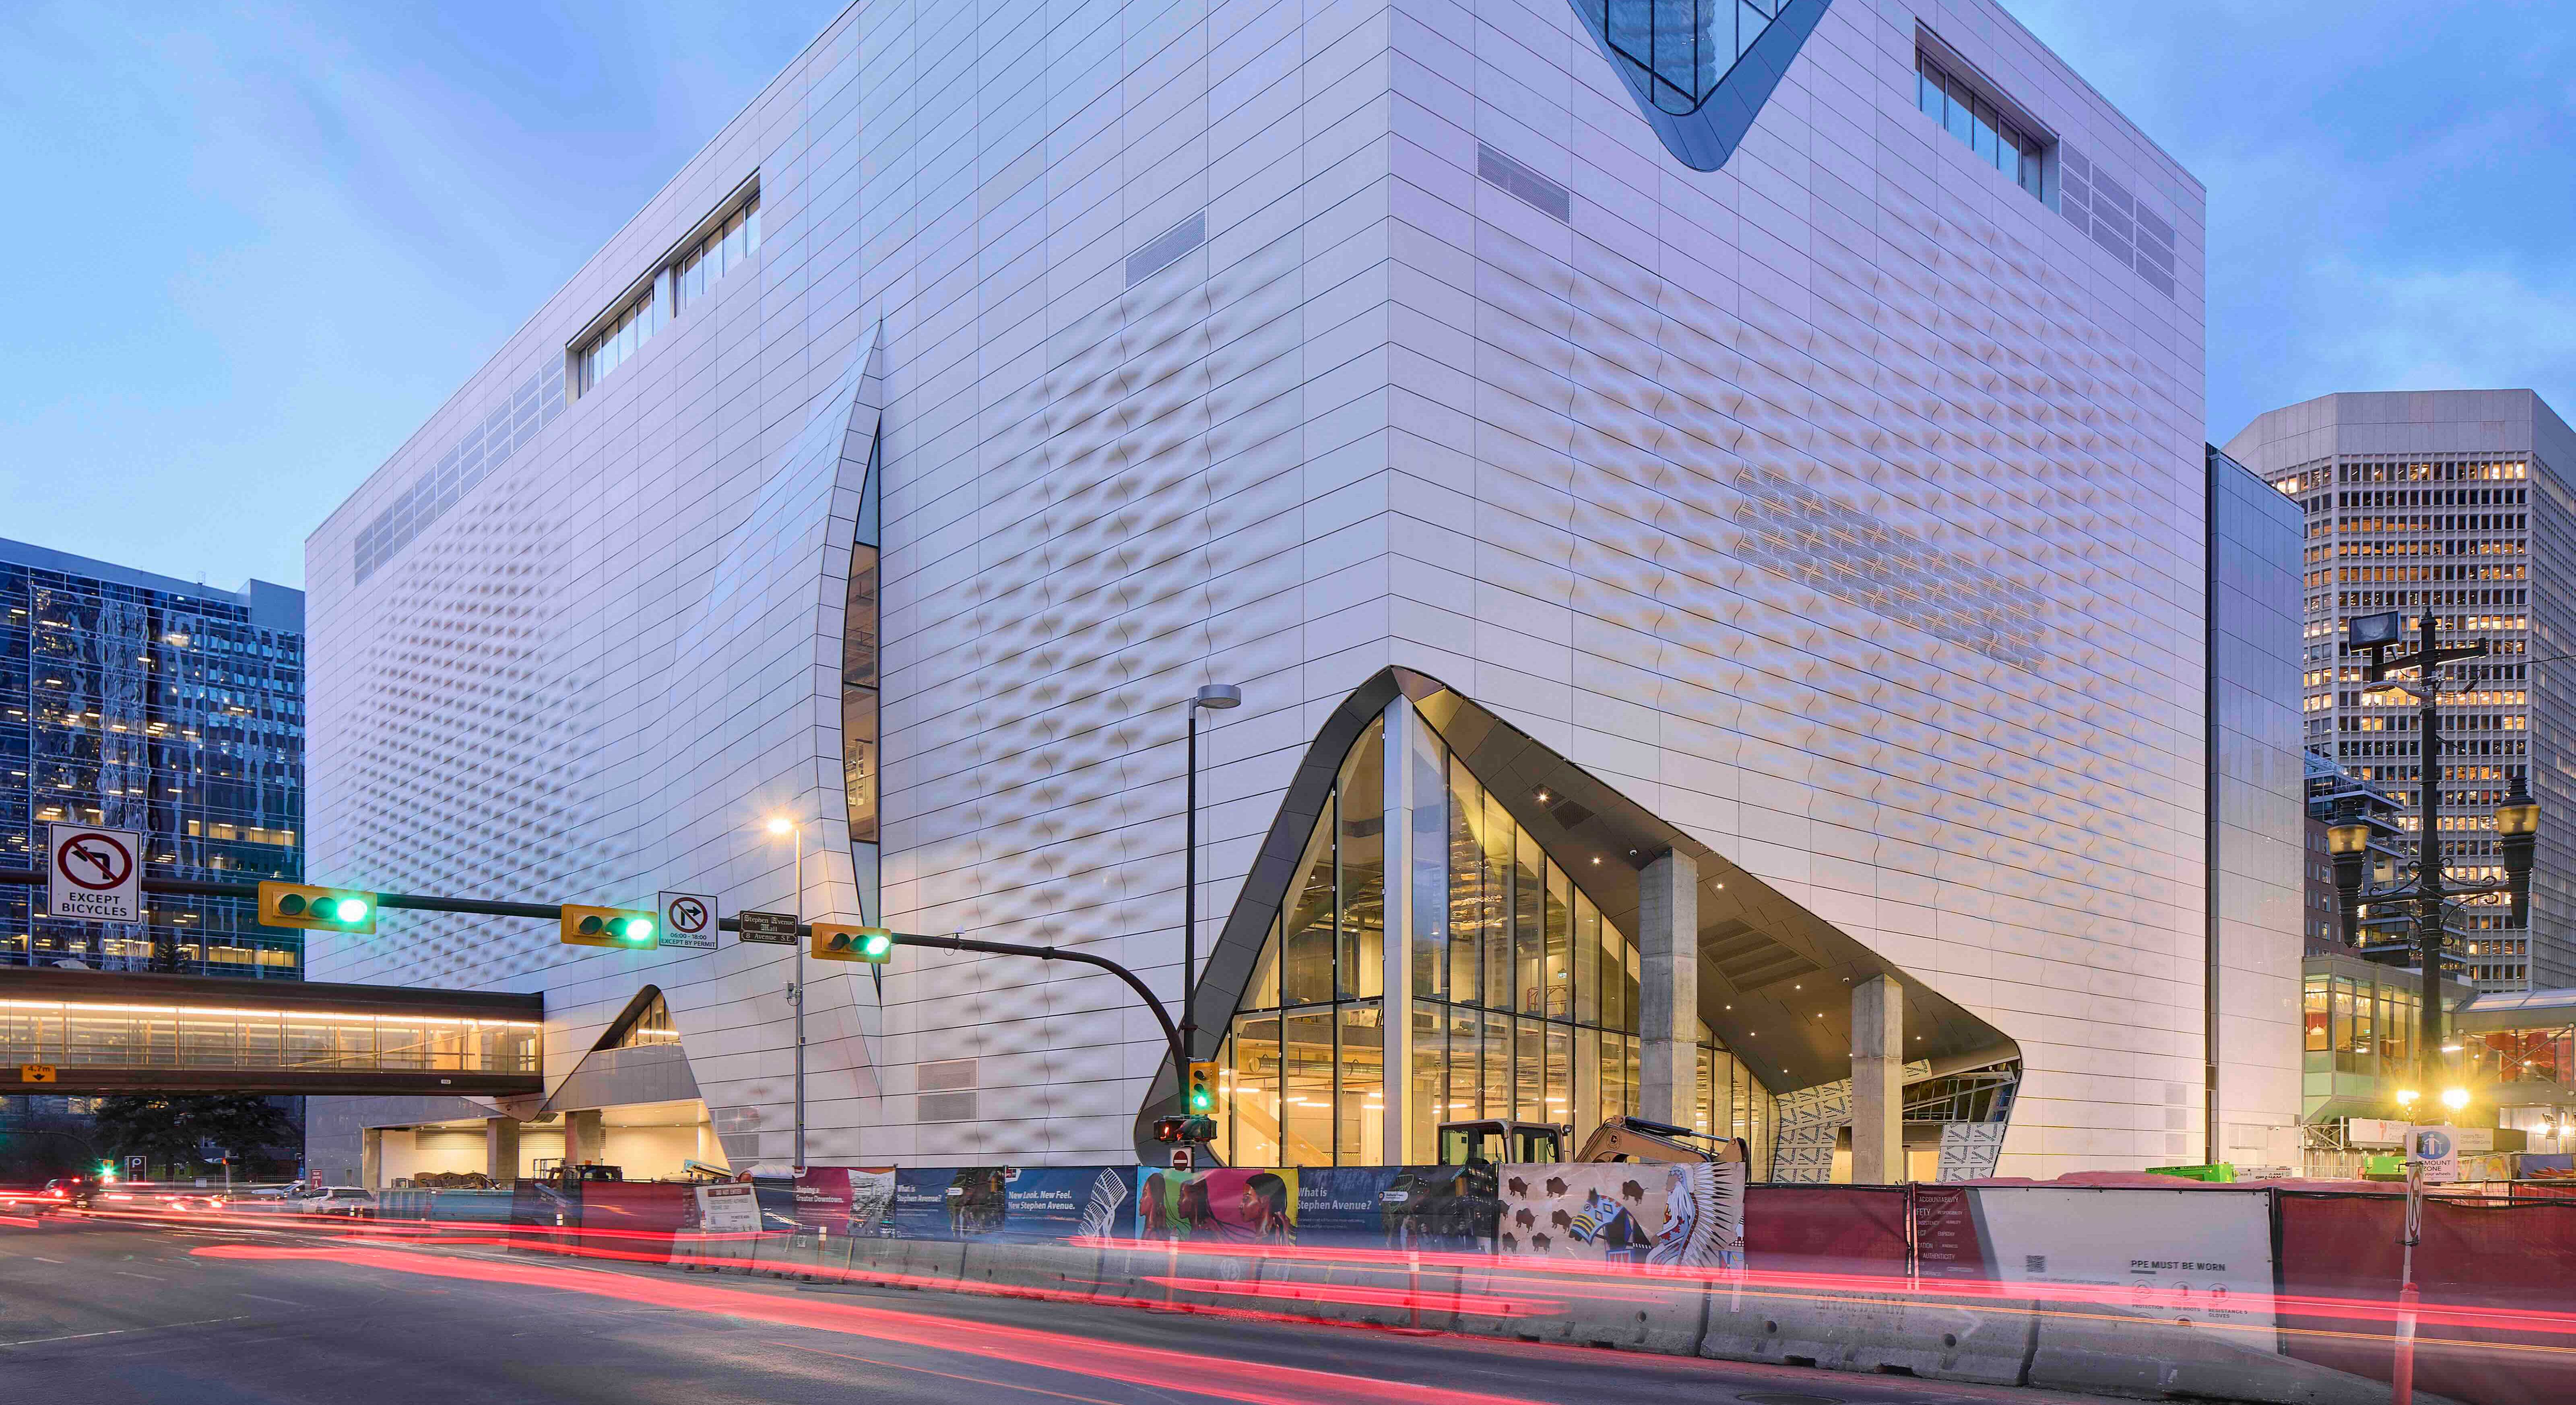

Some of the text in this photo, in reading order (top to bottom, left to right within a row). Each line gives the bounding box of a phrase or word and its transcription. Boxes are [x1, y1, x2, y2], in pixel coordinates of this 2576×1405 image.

[69, 892, 120, 904] EXCEPT
[62, 903, 127, 916] BICYCLES
[744, 915, 794, 925] Stephen Avenue
[760, 924, 777, 932] Mall
[132, 1158, 142, 1168] P
[1023, 1190, 1039, 1199] Look.
[1040, 1190, 1055, 1199] New
[1055, 1190, 1072, 1199] Feel.
[1298, 1187, 1327, 1197] What is
[1008, 1201, 1075, 1211] New Stephen Avenue.
[1298, 1200, 1372, 1212] Stephen Avenue?
[2151, 1261, 2179, 1269] MUST
[2196, 1263, 2225, 1271] WORN
